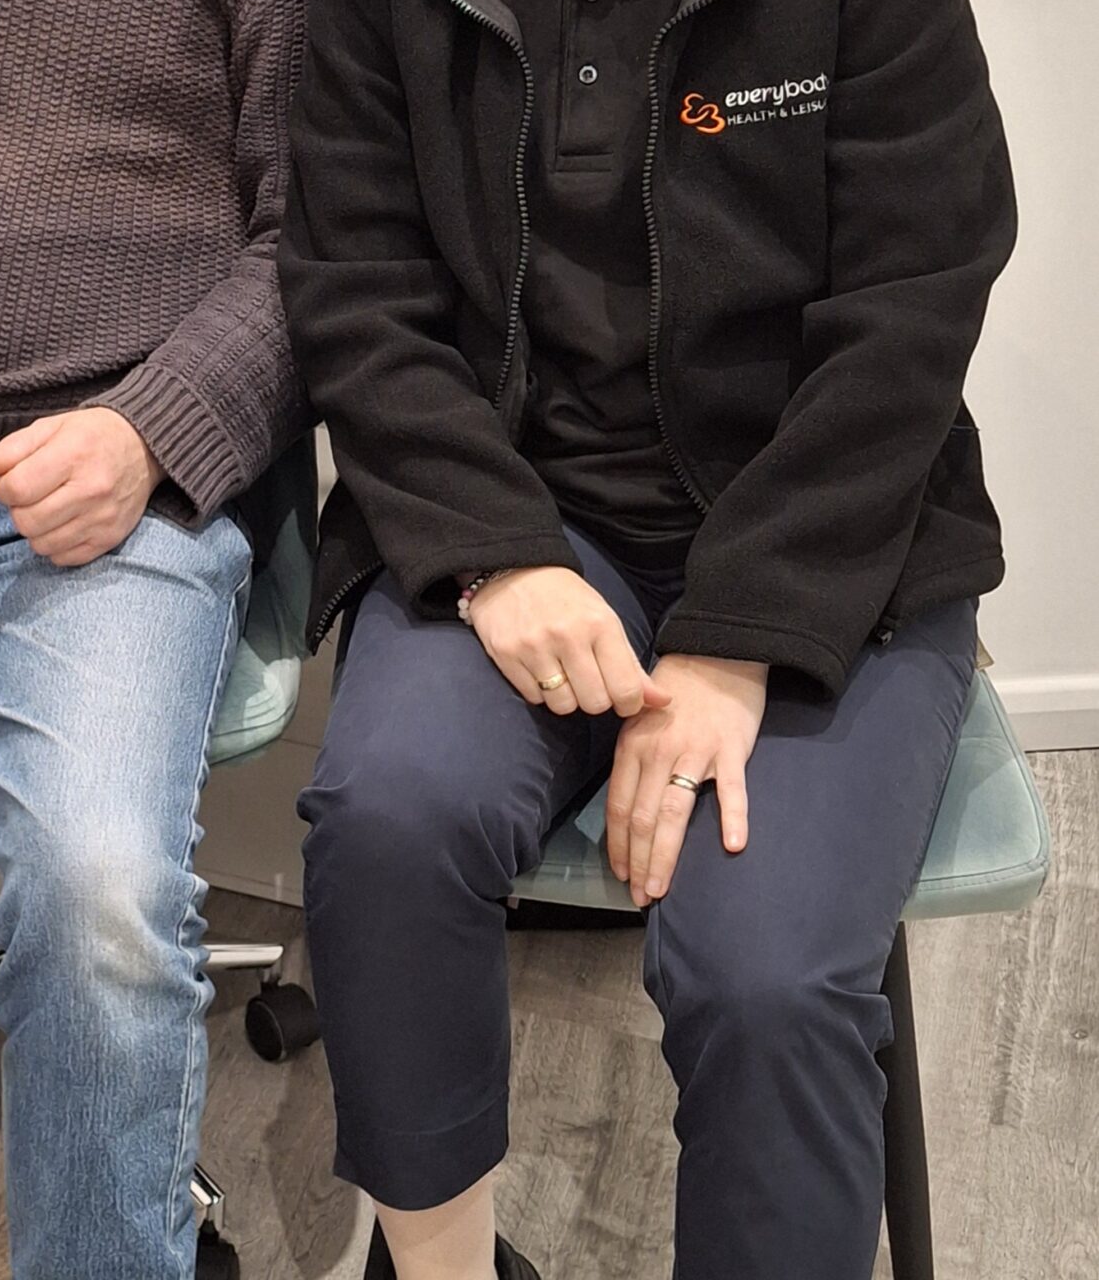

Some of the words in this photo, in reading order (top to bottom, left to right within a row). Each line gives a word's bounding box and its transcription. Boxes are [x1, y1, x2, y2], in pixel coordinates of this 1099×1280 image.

[725, 72, 830, 108] everybod
[727, 109, 776, 126] HEALTH
[780, 107, 788, 118] &
[791, 97, 828, 116] LEISU
